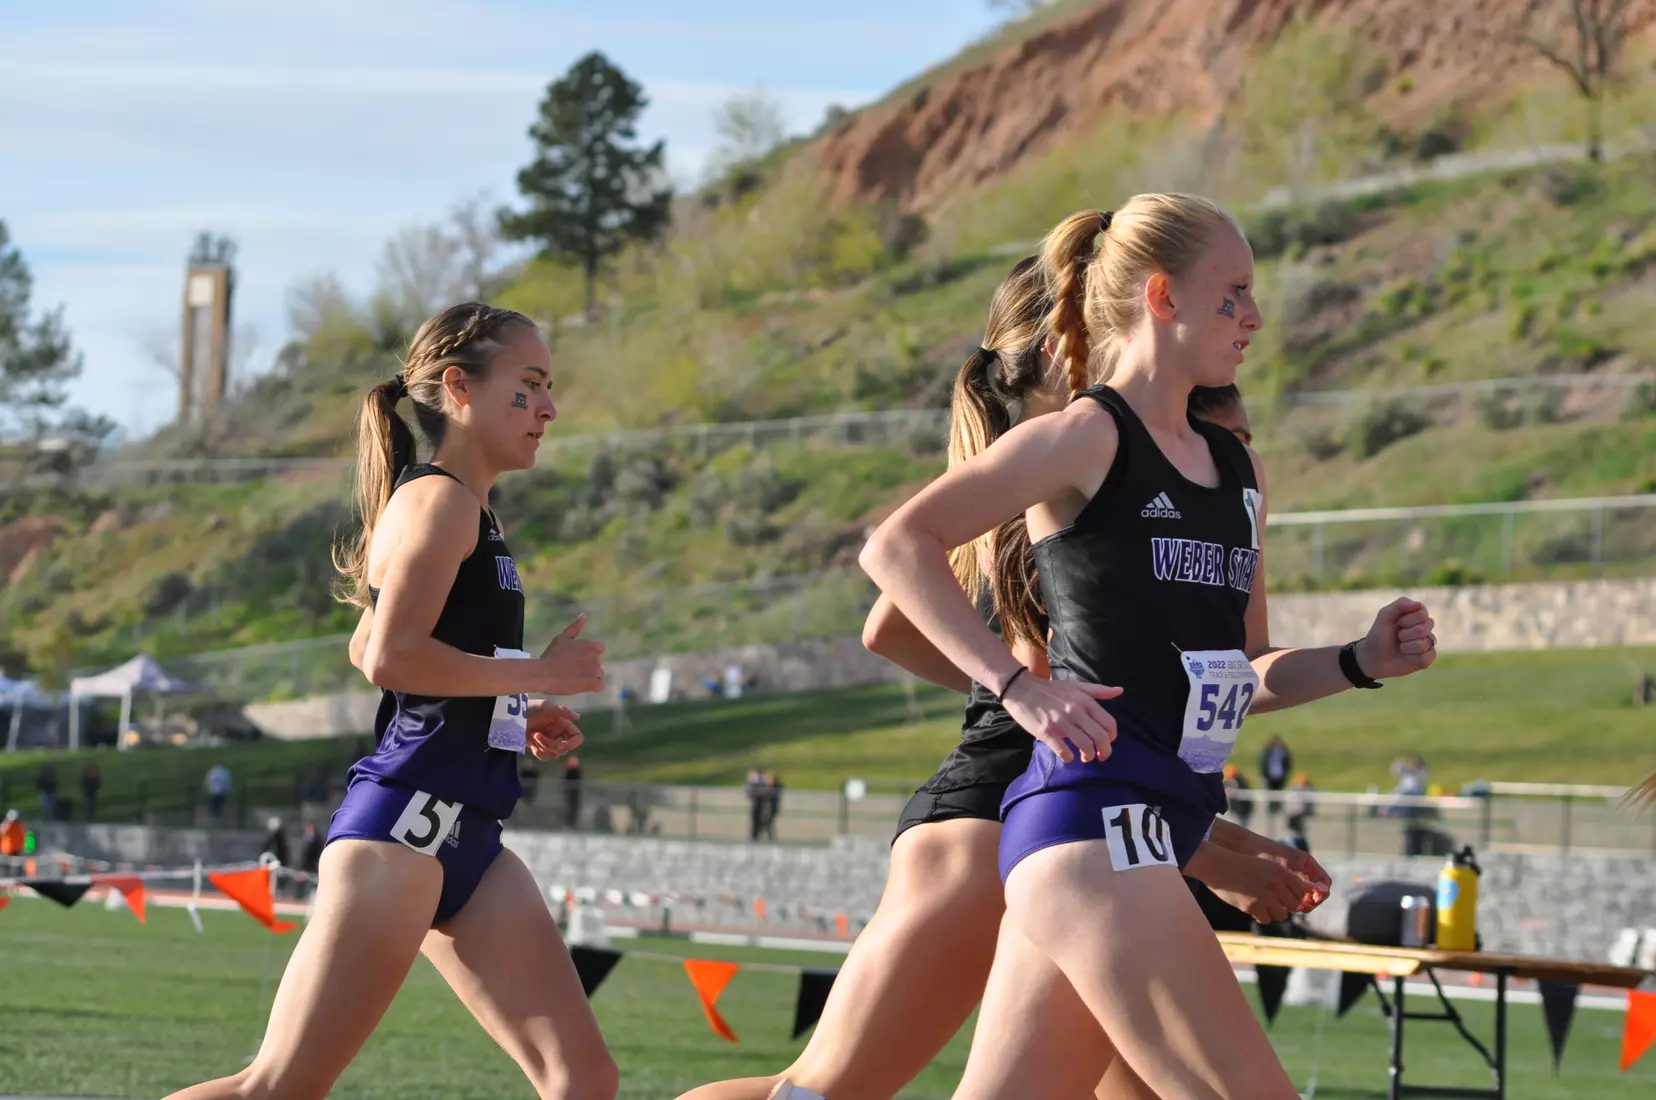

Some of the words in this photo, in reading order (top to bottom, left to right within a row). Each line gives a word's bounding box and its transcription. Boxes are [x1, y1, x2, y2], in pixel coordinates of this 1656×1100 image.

[1141, 507, 1182, 519] adidas
[495, 556, 524, 593] WE
[1151, 537, 1225, 586] WEBER
[1207, 660, 1226, 669] 2022
[1196, 682, 1254, 731] 542
[404, 794, 454, 848] 5
[1110, 806, 1169, 866] 10
